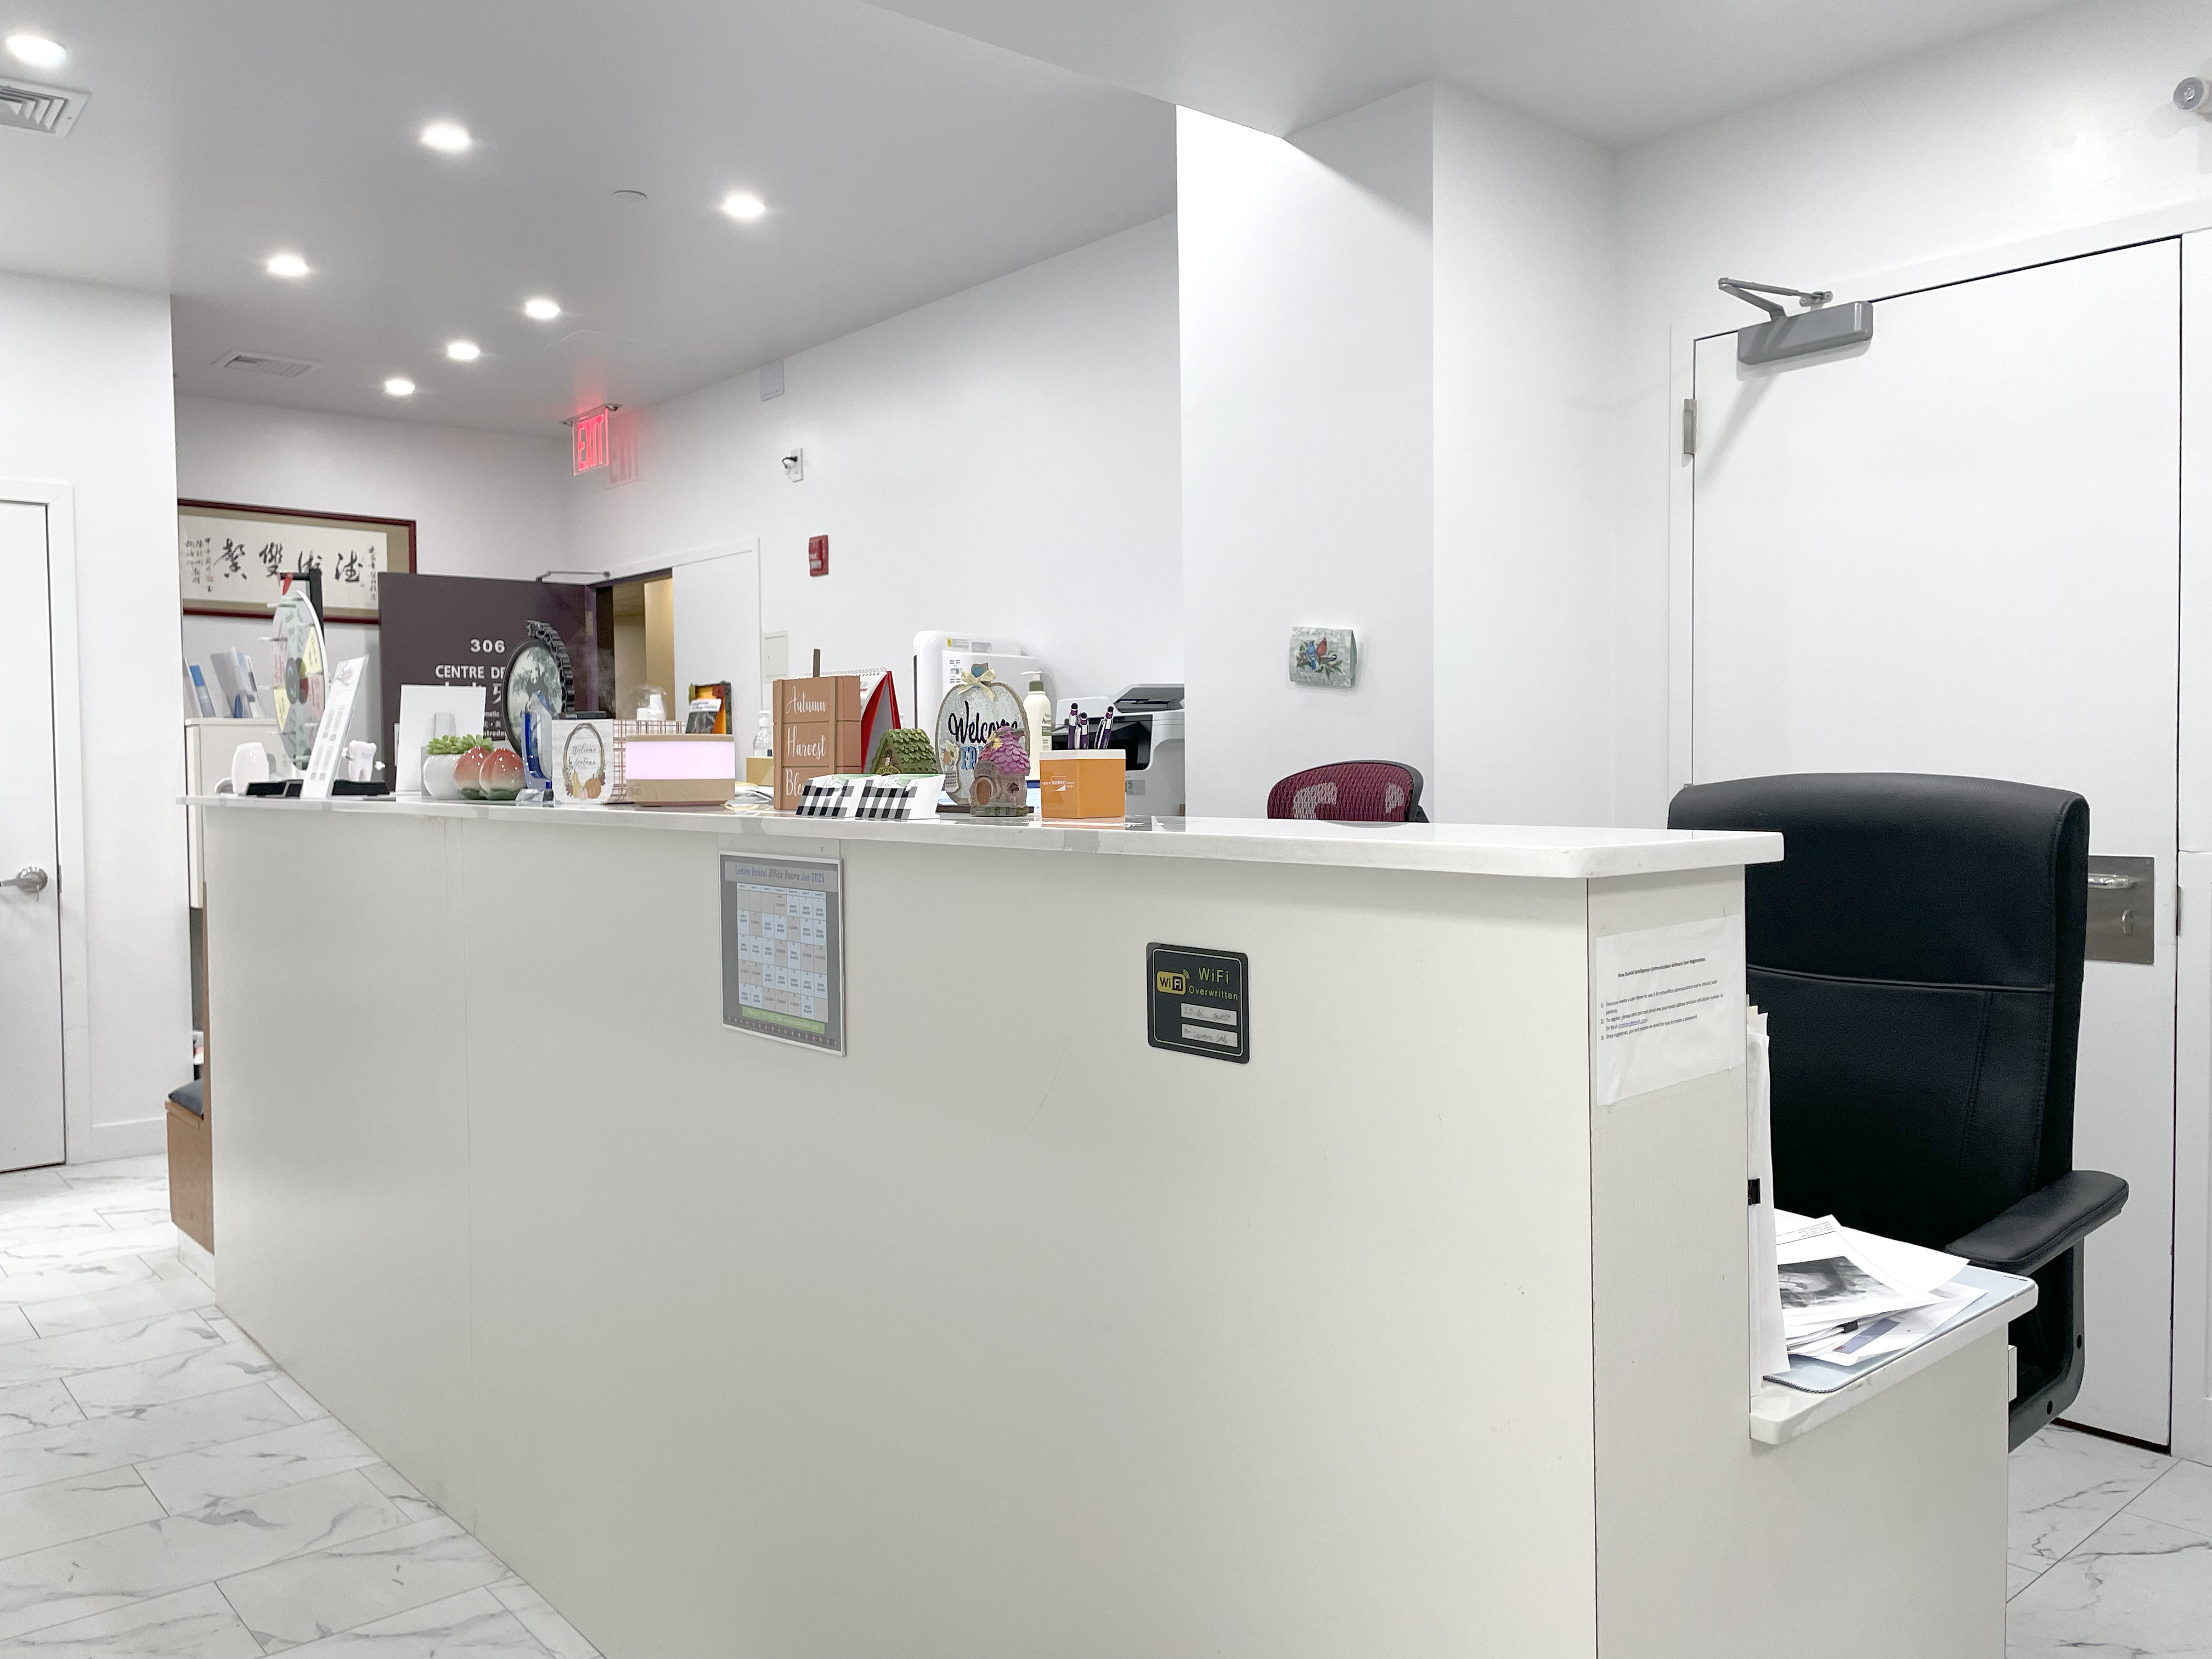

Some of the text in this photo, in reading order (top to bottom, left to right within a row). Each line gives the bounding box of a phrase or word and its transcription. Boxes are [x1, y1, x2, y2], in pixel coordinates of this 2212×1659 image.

[577, 414, 603, 471] EXIT
[470, 639, 505, 653] 306
[435, 665, 485, 679] CENTRE
[786, 685, 826, 714] Autumn
[786, 725, 826, 760] Harvest
[769, 868, 783, 879] Office
[785, 870, 799, 881] Hours
[801, 872, 810, 882] Jan
[1159, 976, 1182, 990] WiFi
[1198, 967, 1229, 984] WiFi
[1188, 985, 1238, 1001] Overwritten
